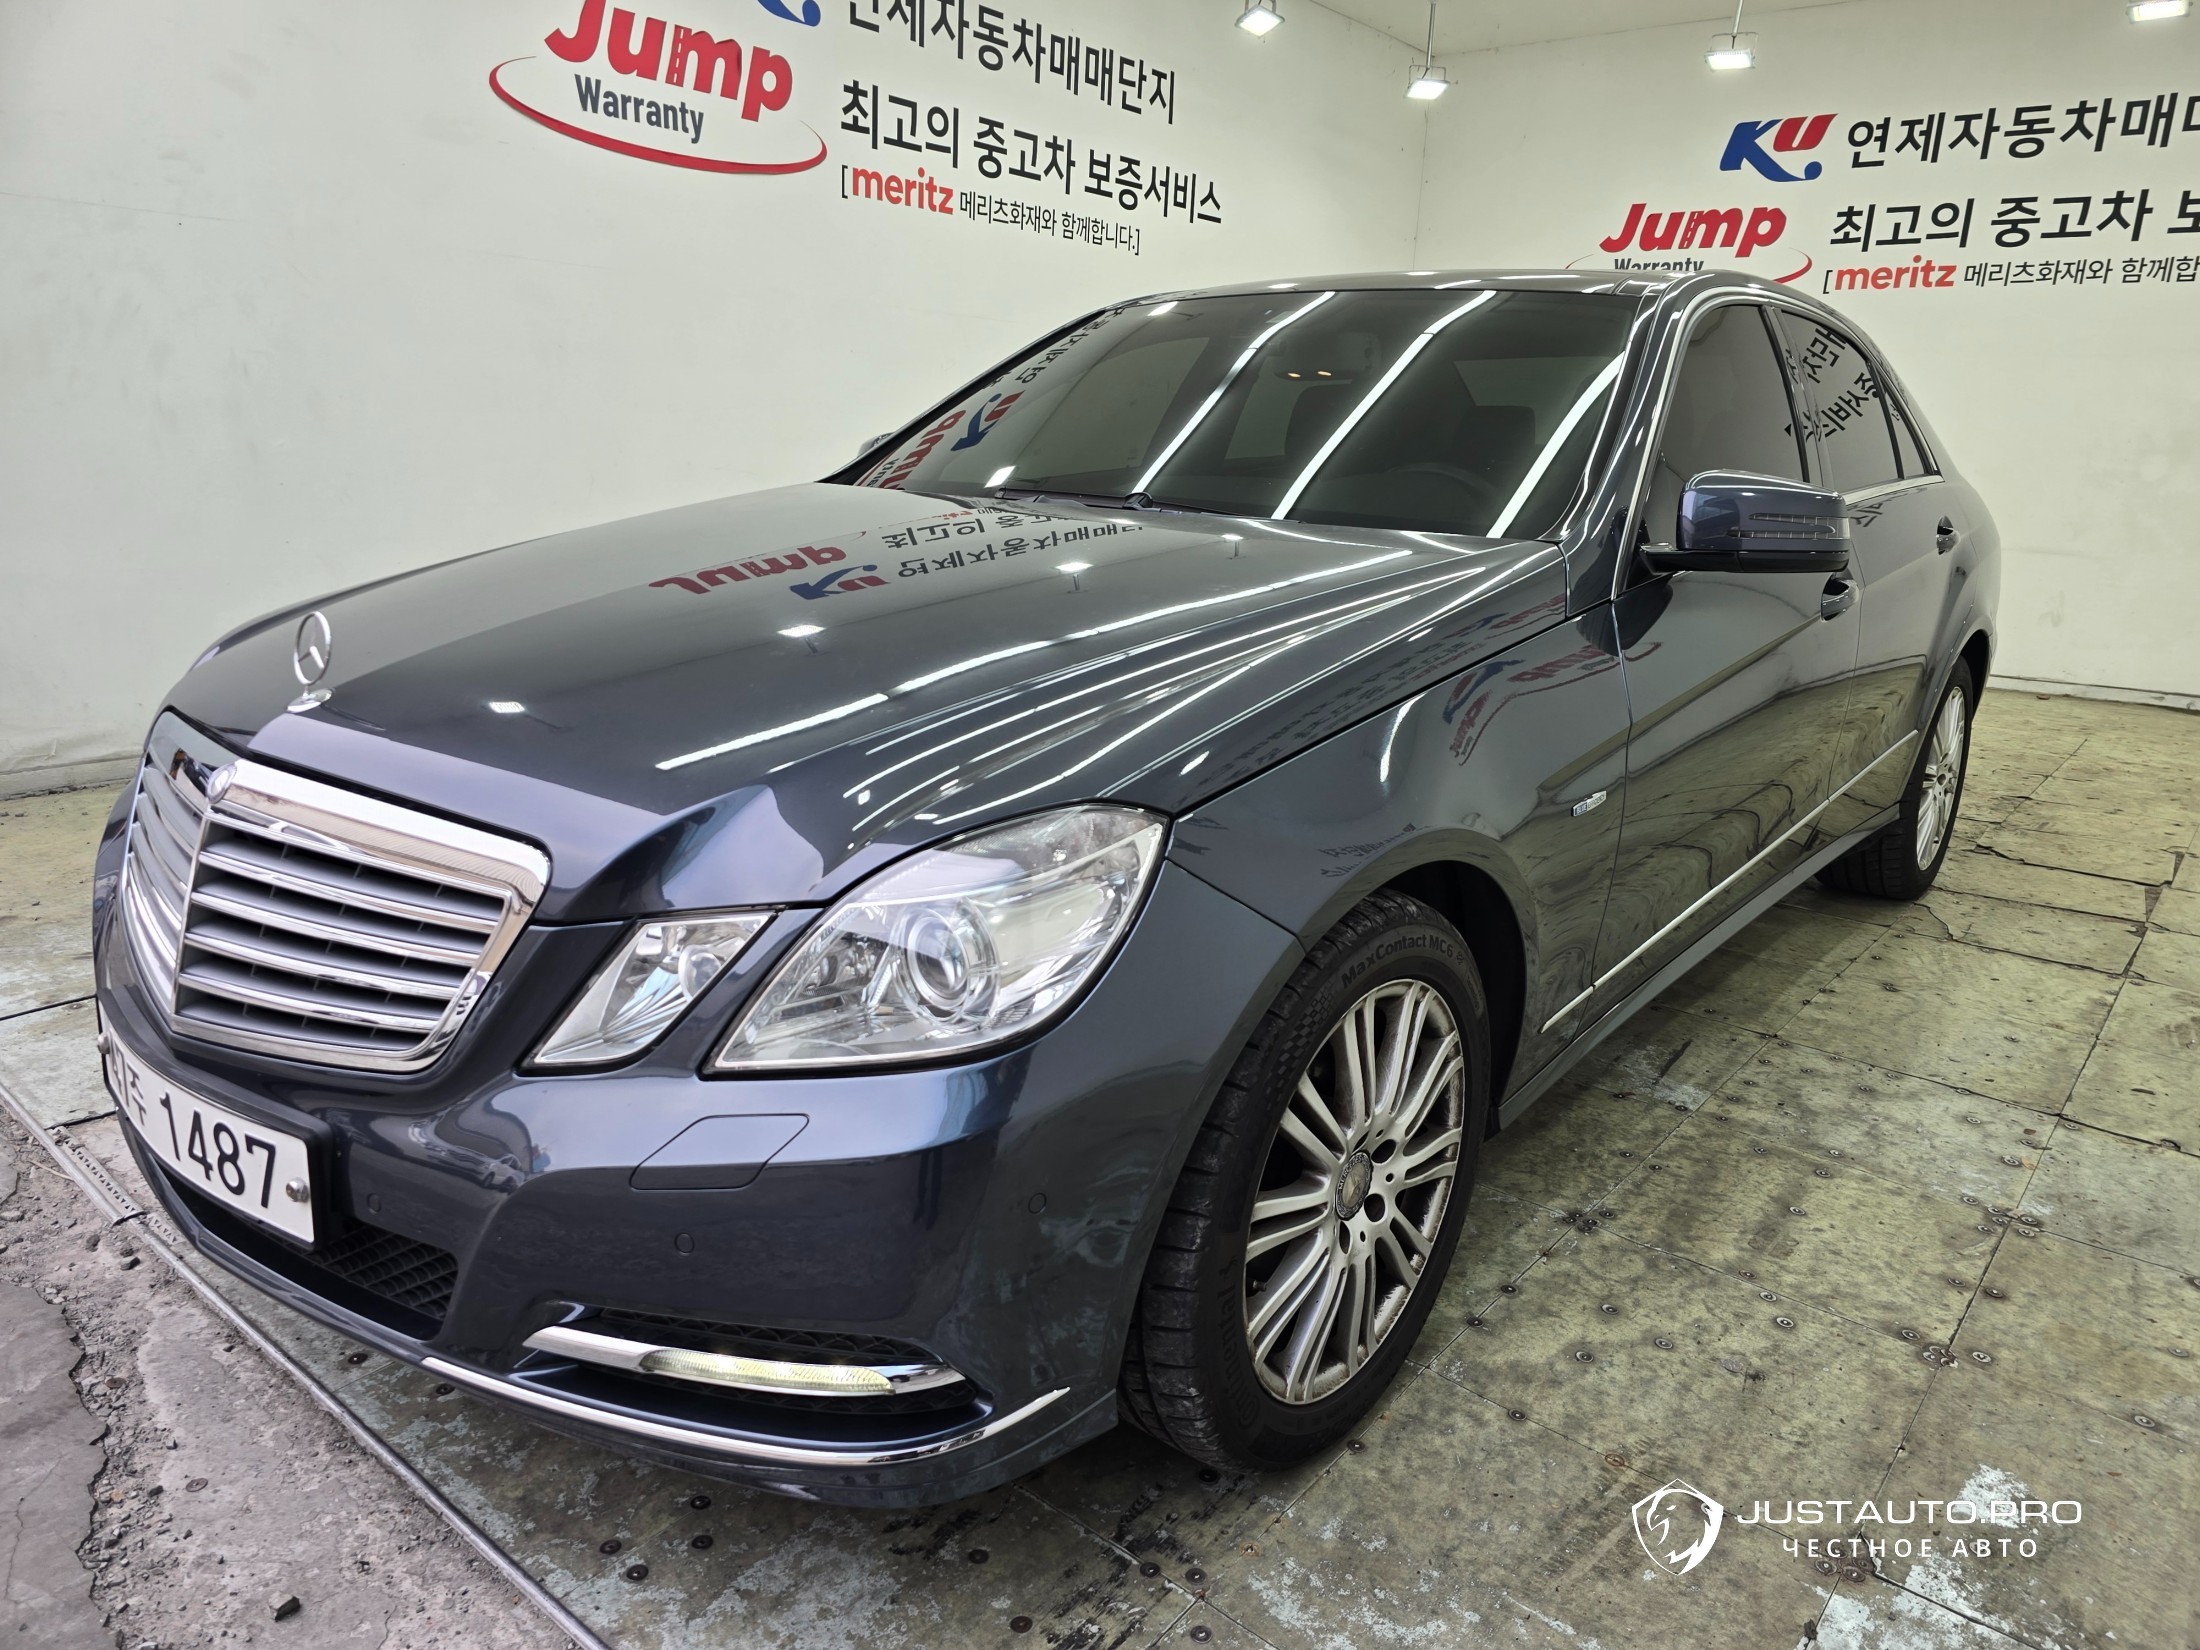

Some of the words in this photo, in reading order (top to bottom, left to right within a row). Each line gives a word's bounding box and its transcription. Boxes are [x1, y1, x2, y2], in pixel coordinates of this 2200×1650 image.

[544, 0, 793, 122] Jump
[574, 74, 704, 144] Warranty
[1848, 92, 2200, 168] 연제자동차매
[840, 79, 959, 168] 최고의
[973, 116, 1076, 195] 중고차
[1084, 149, 1222, 224] 보증서비스
[959, 190, 1057, 236] 메리츠화재와
[1061, 211, 1140, 256] 함께합니다.]
[1599, 203, 1787, 258] Jump
[1830, 198, 1975, 252] 최고의
[1991, 189, 2154, 248] 중고차
[1614, 257, 1704, 272] Warranty
[1964, 258, 2113, 287] 메리츠화재와
[1429, 934, 1454, 959] MC6
[159, 1091, 276, 1209] 1487
